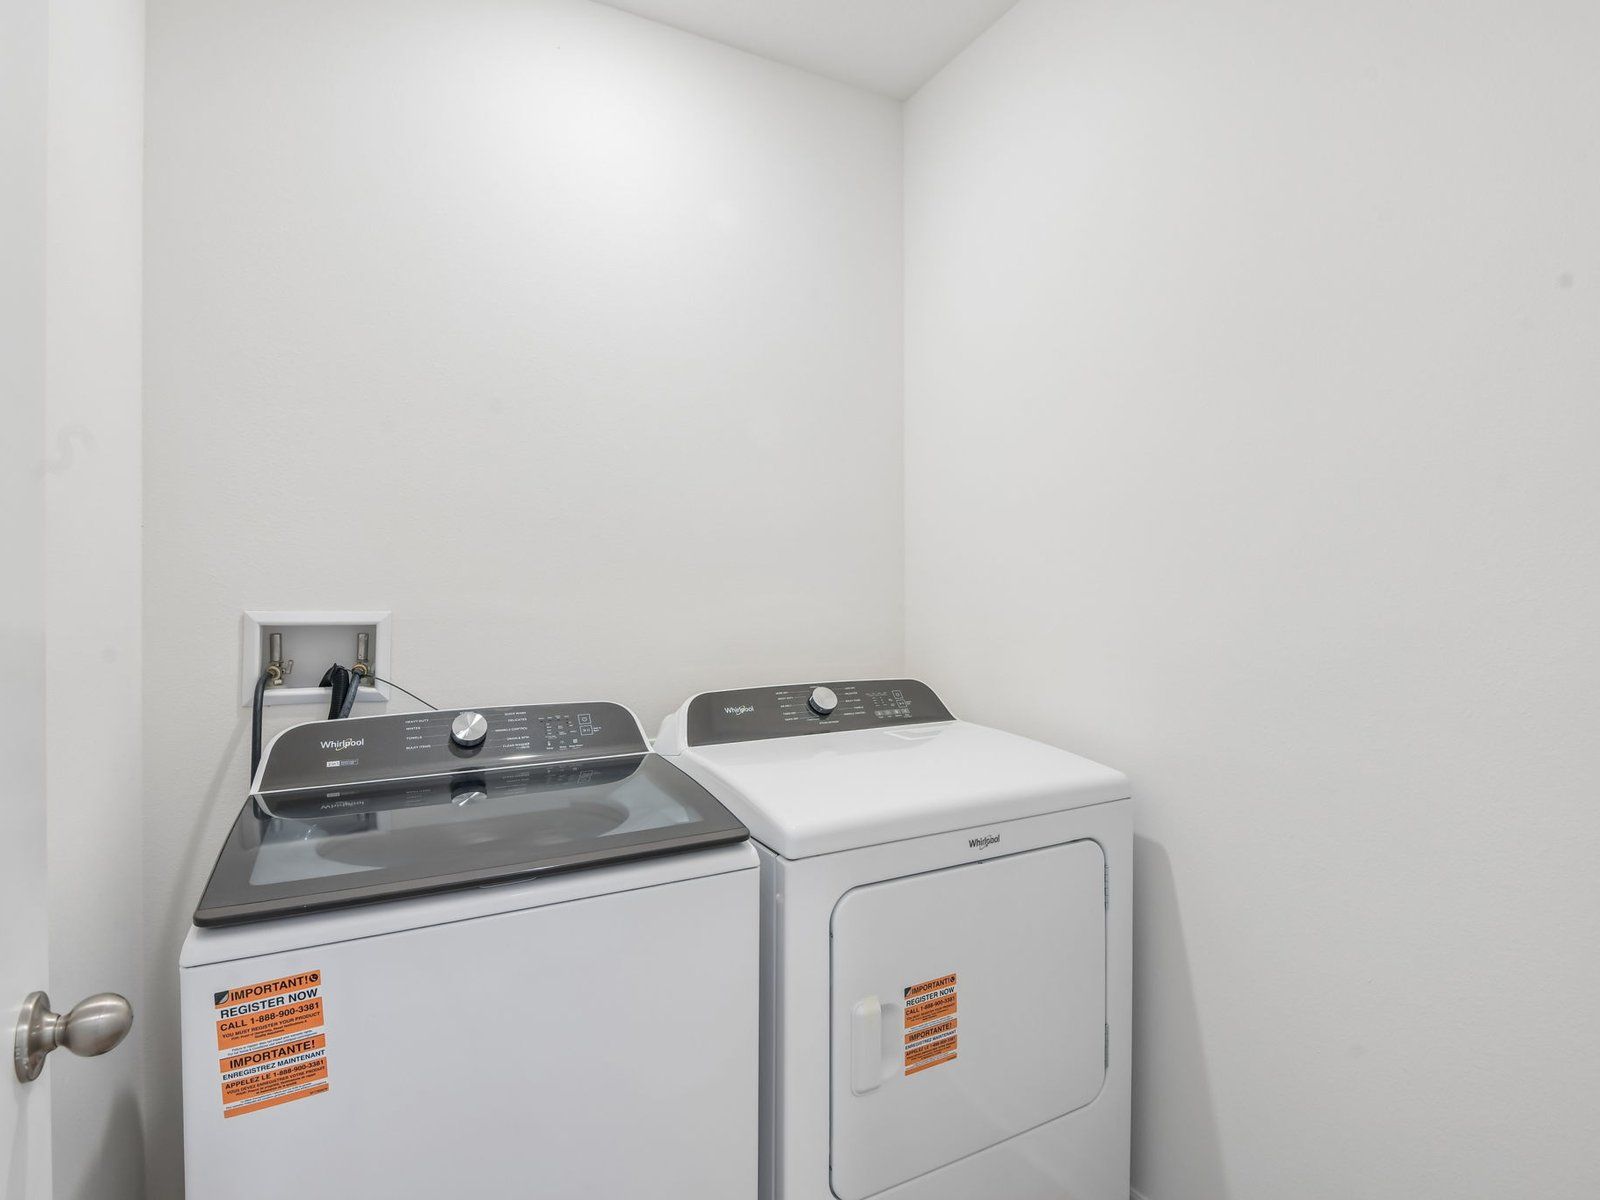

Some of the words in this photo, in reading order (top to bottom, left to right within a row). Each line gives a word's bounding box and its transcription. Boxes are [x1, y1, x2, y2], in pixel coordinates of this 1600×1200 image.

[724, 705, 755, 715] Whirlpool
[320, 738, 365, 752] Whirlpool
[968, 834, 1001, 850] Whirlpool
[230, 974, 308, 1002] IMPORTANT!
[905, 990, 939, 1007] REGISTER
[939, 986, 955, 996] NOW
[220, 996, 285, 1019] REGISTER
[288, 988, 319, 1003] NOW
[220, 1018, 248, 1032] CALL
[250, 1002, 320, 1025] 1-888-900-3381
[222, 1059, 276, 1081] ENREGISTREZ
[277, 1049, 326, 1067] MAINTENANT
[229, 1039, 316, 1069] IMPORTANTE!
[225, 1076, 260, 1090] APPELEZ
[261, 1073, 272, 1081] LE
